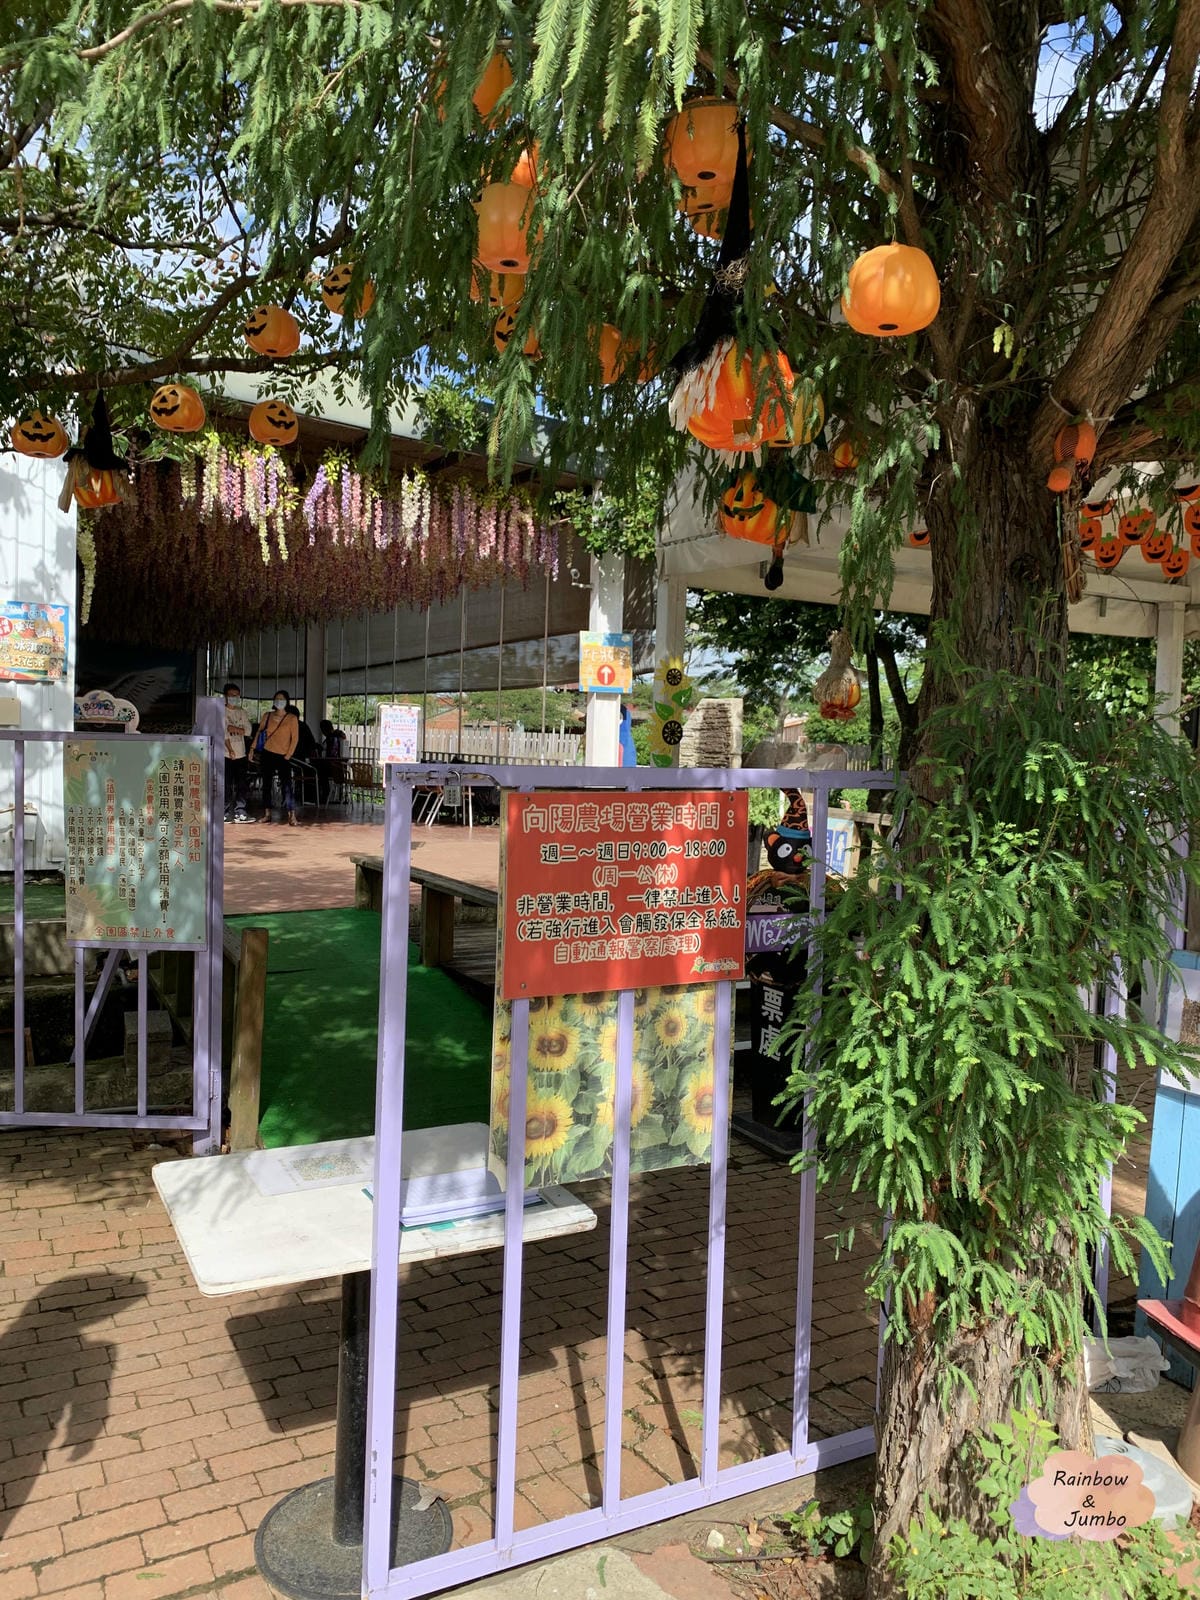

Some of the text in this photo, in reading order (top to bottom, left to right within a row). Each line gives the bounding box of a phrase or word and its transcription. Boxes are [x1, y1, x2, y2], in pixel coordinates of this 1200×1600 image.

[188, 761, 201, 863] 向陽農場入園須知
[522, 802, 735, 833] 向陽農場營業時間:
[592, 863, 678, 887] (周一公休)
[554, 934, 701, 964] 自動通報警察處理)
